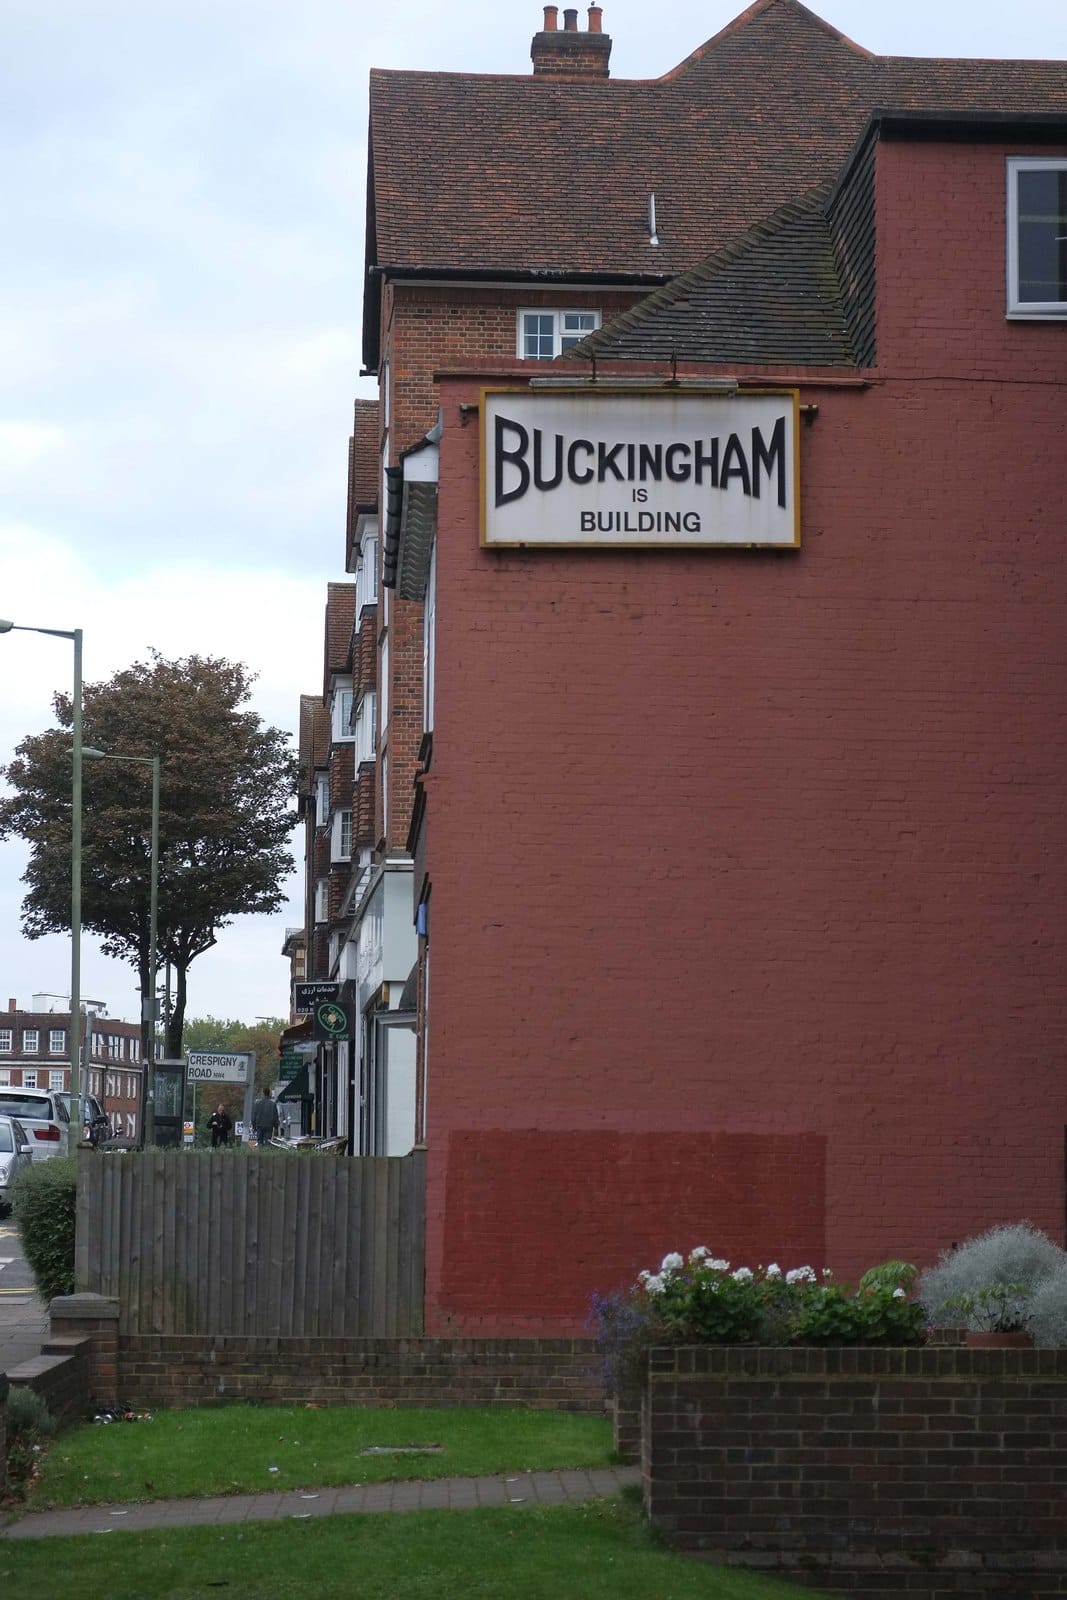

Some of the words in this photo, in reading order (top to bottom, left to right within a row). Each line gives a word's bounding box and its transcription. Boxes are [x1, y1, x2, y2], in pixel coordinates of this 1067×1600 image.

[495, 414, 786, 509] BUCKINGHAM
[632, 488, 648, 502] IS
[580, 511, 701, 532] BUILDING
[190, 1055, 238, 1067] CRESPIGNY
[188, 1067, 212, 1078] ROAD
